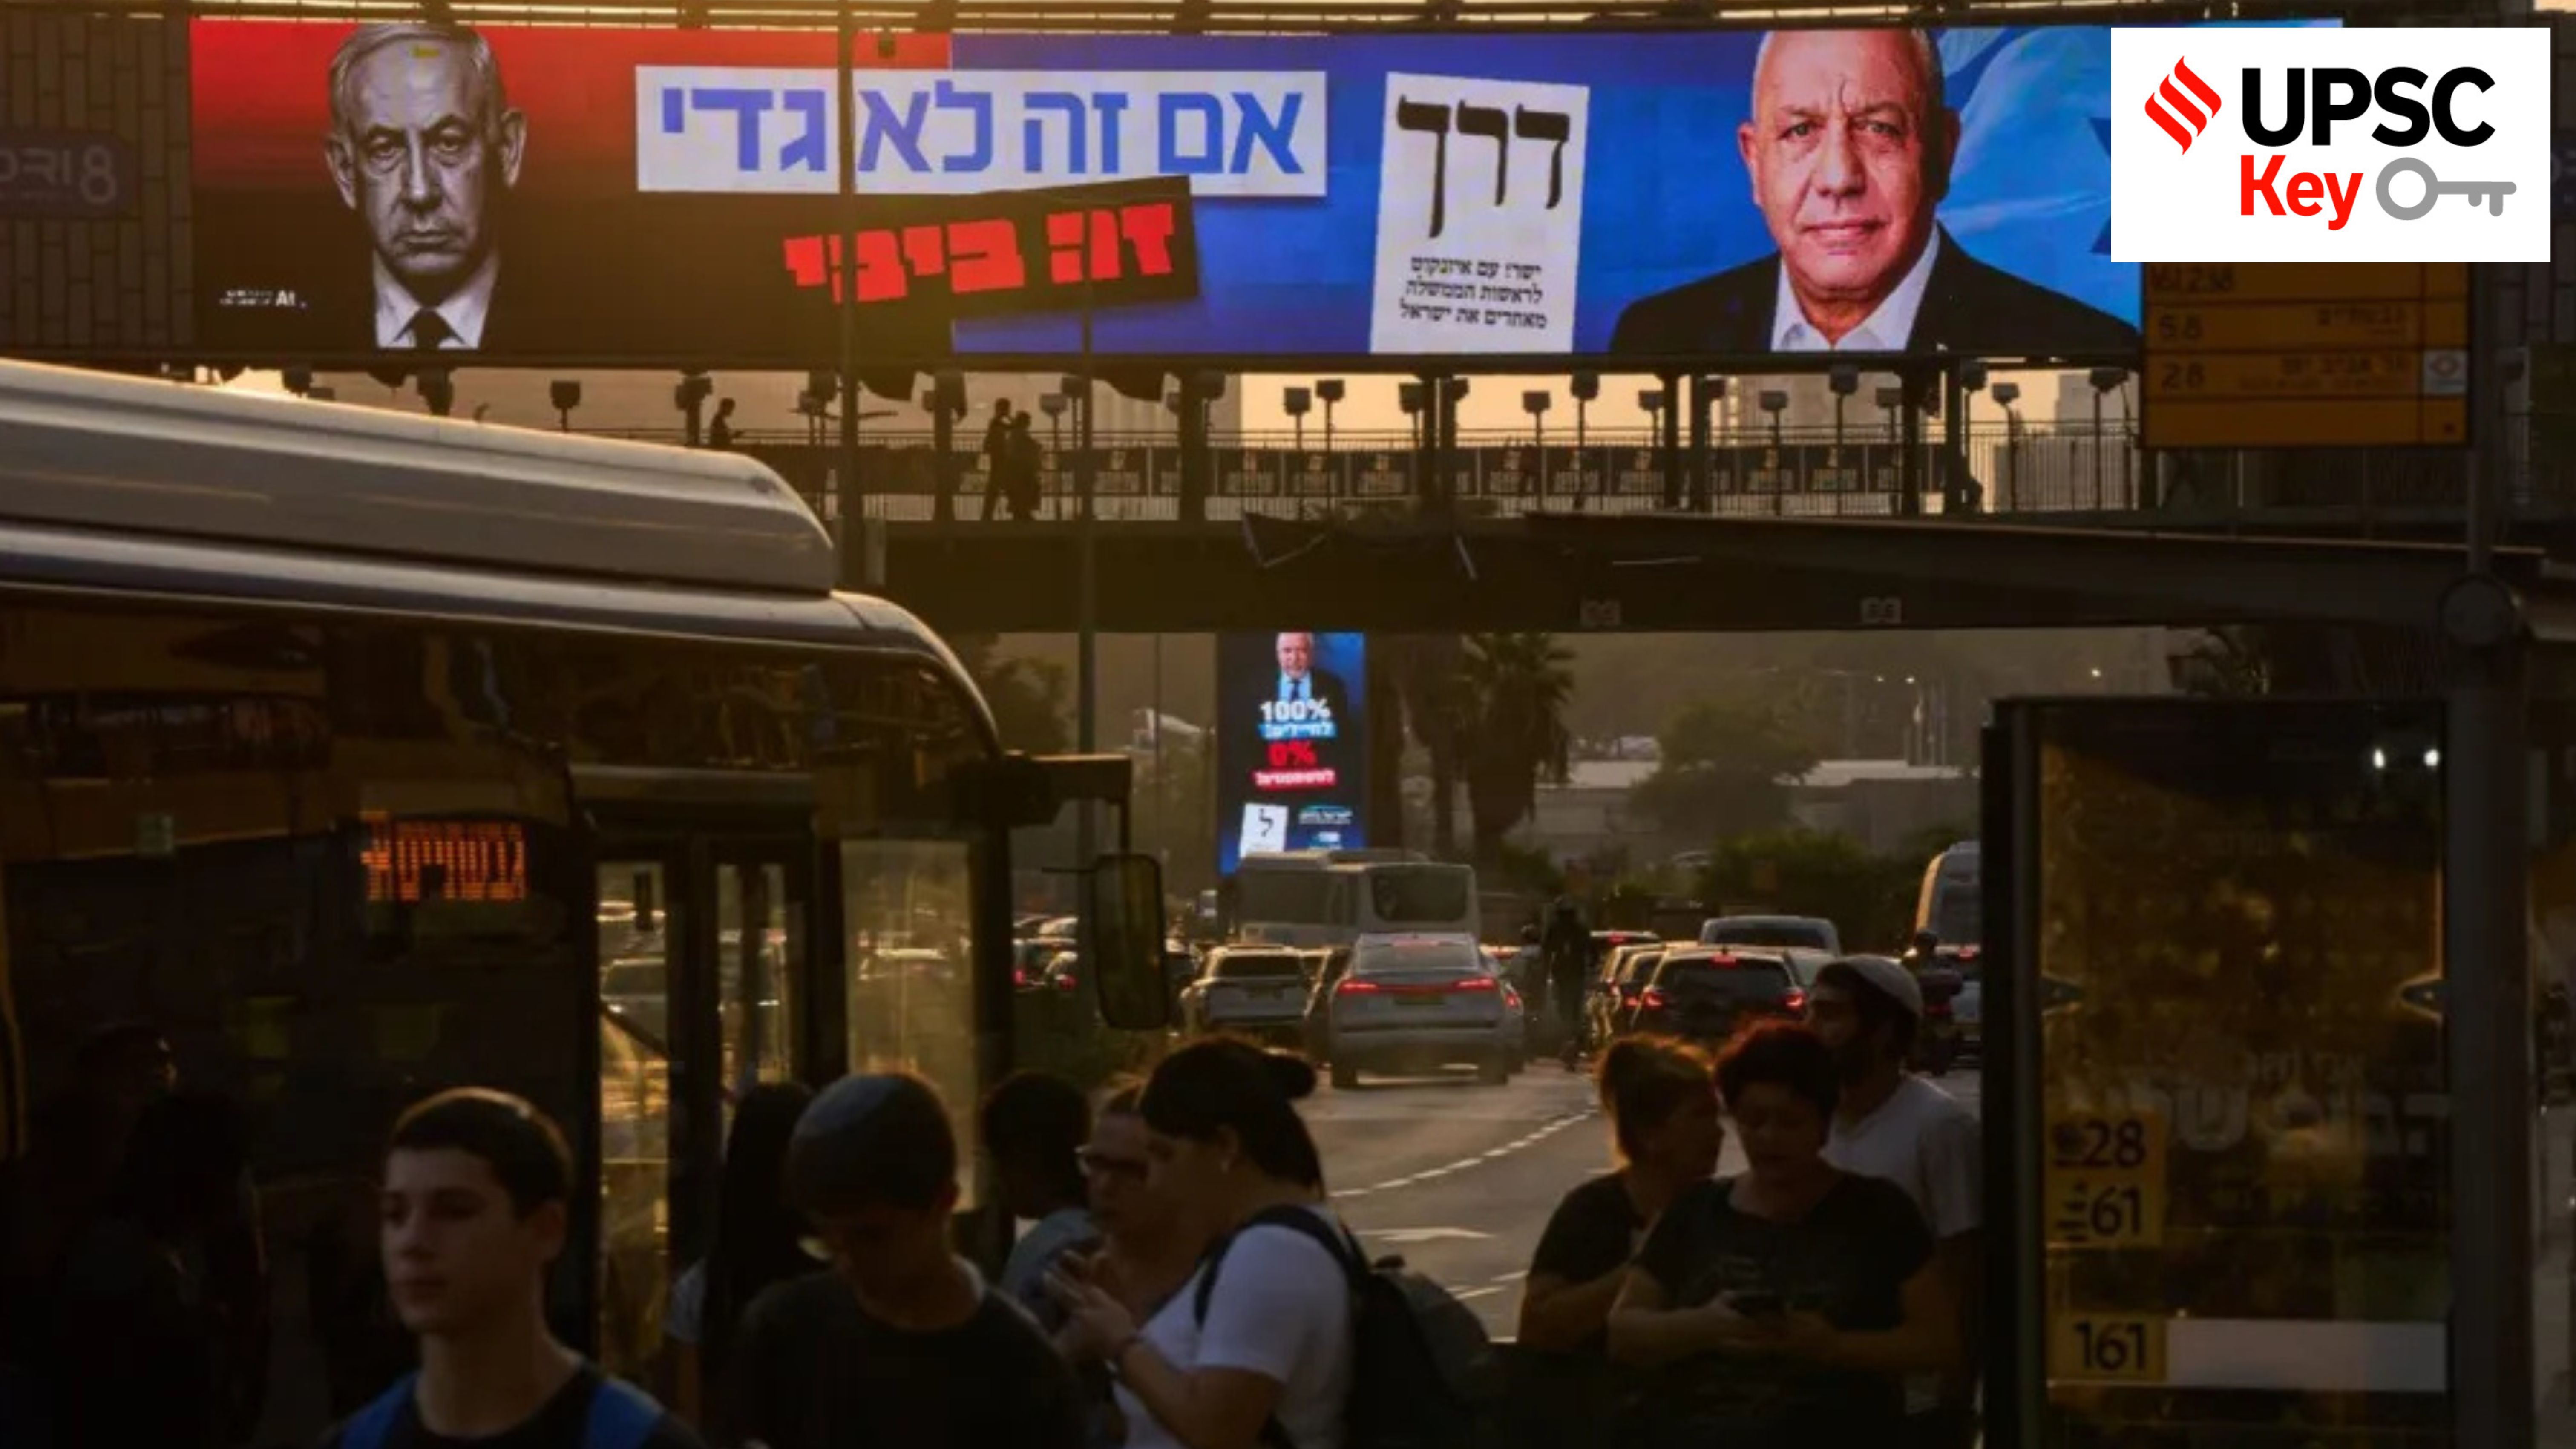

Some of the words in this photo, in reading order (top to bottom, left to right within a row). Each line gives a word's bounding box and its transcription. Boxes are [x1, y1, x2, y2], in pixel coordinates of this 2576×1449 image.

[661, 88, 827, 172] גדי
[858, 80, 994, 174] לא
[1023, 91, 1130, 175] זה
[1157, 90, 1305, 176] אם
[1397, 95, 1570, 239] דרך
[783, 218, 1026, 304] ביבי
[1046, 203, 1174, 285] זה
[1477, 260, 1500, 278] עם
[1455, 308, 1481, 323] את
[1479, 283, 1543, 303] לראשות
[2161, 363, 2206, 390] 28
[1259, 697, 1331, 722] 100%
[1268, 739, 1317, 767] 0%
[2083, 1119, 2147, 1169] 28
[2091, 1185, 2142, 1236] 61
[2075, 1321, 2147, 1371] 161
